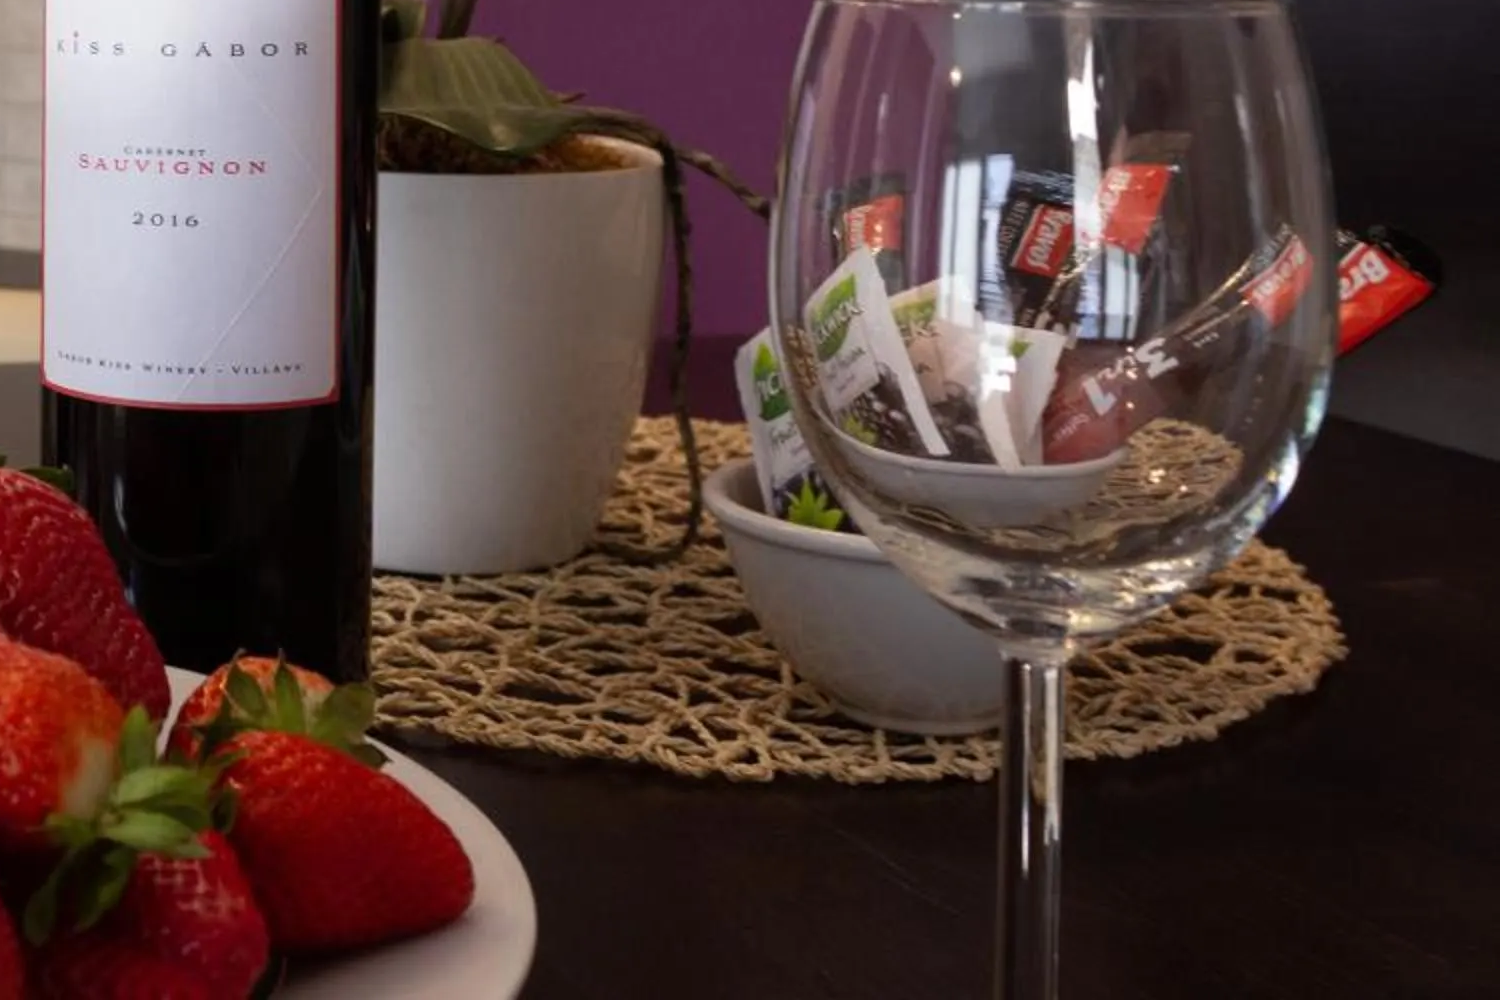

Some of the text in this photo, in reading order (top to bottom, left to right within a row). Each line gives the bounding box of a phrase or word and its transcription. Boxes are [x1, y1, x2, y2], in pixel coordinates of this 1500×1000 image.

[78, 153, 267, 175] SAUVIGNON
[132, 210, 201, 229] 2016
[1338, 250, 1392, 302] Bra
